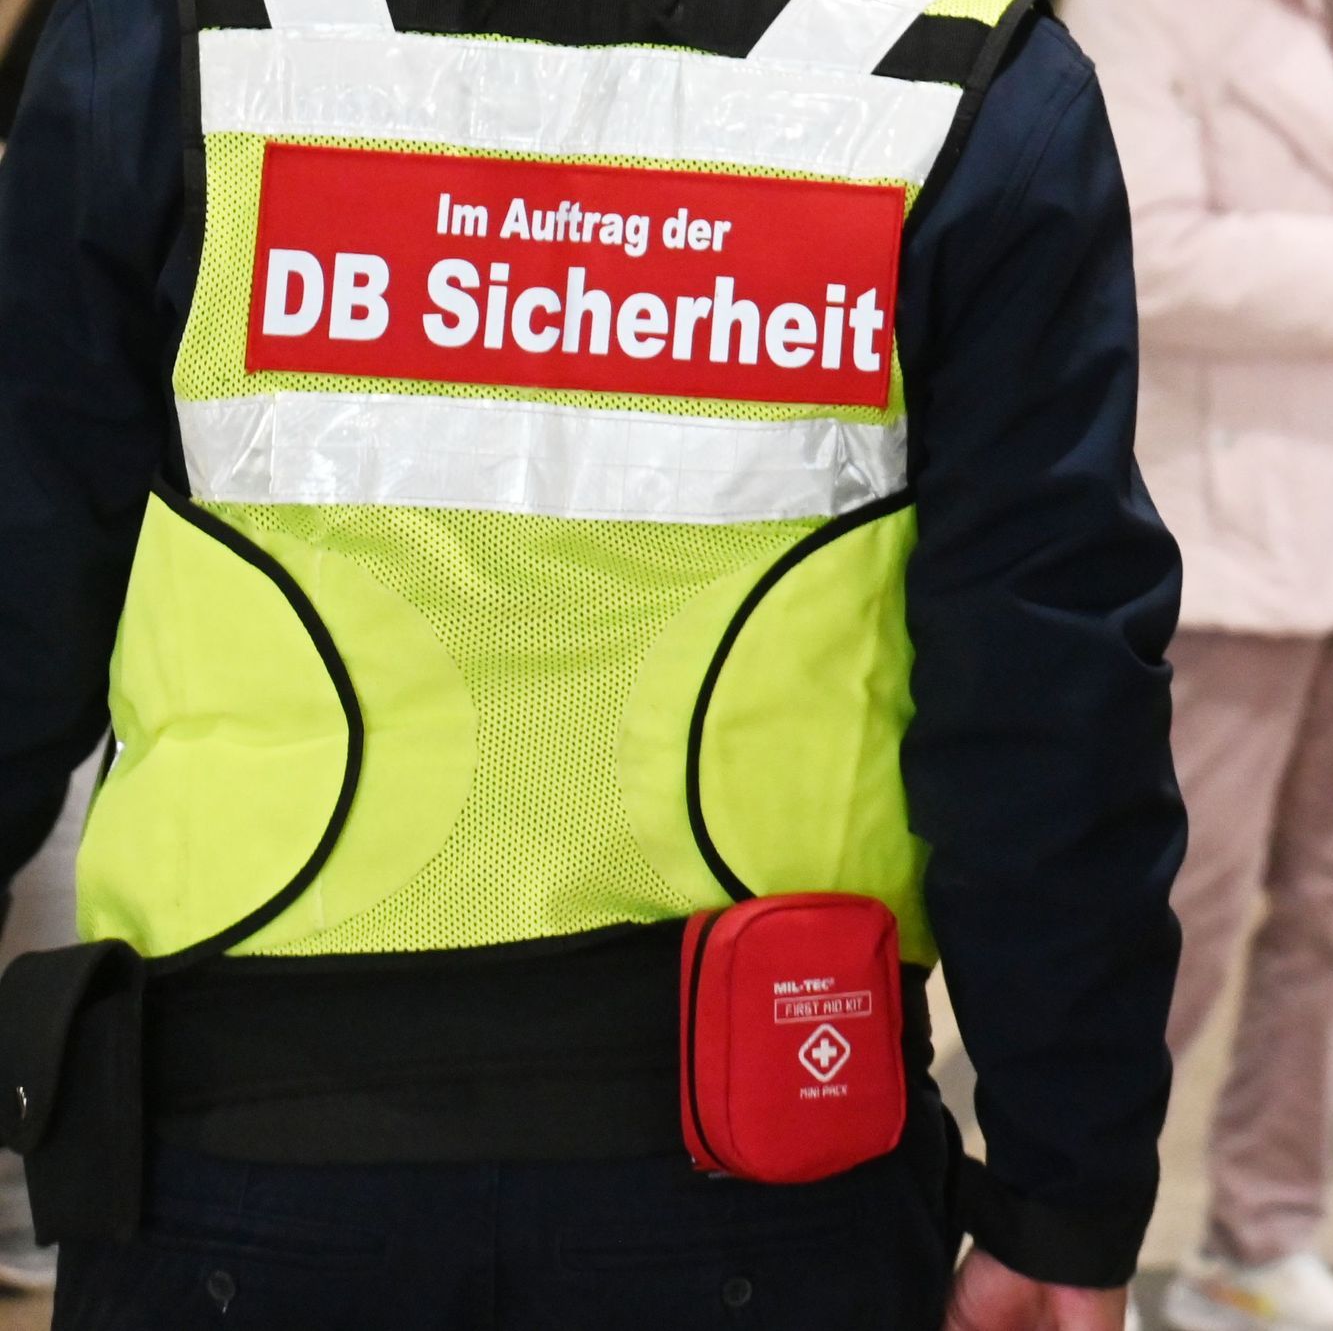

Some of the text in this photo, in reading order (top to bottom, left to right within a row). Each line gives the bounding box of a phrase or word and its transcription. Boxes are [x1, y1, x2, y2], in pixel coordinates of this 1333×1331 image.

[436, 193, 732, 257] Im Auftrag der
[262, 248, 884, 372] DB Sicherheit
[785, 996, 863, 1018] FIRST AID KIT
